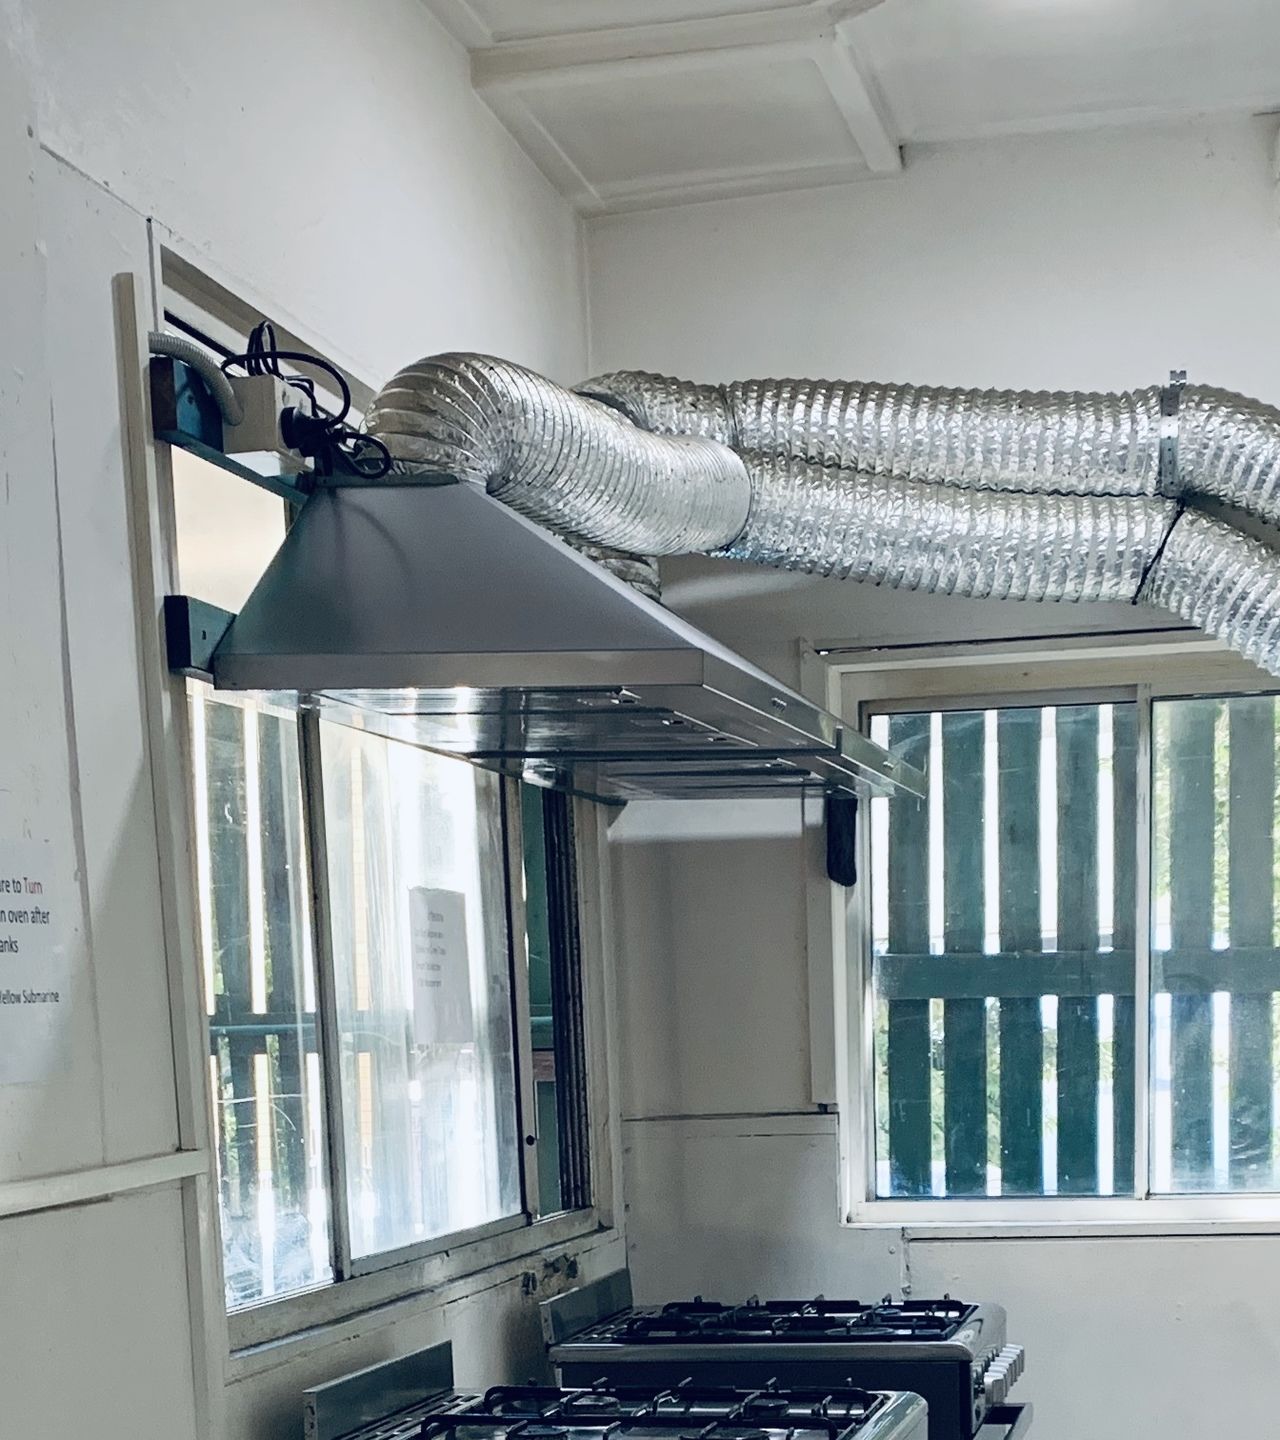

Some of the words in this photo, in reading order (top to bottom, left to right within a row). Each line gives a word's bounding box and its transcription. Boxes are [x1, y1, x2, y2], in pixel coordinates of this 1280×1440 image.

[12, 878, 22, 894] to
[24, 877, 43, 894] Turn
[8, 909, 29, 924] oven
[31, 906, 50, 925] after
